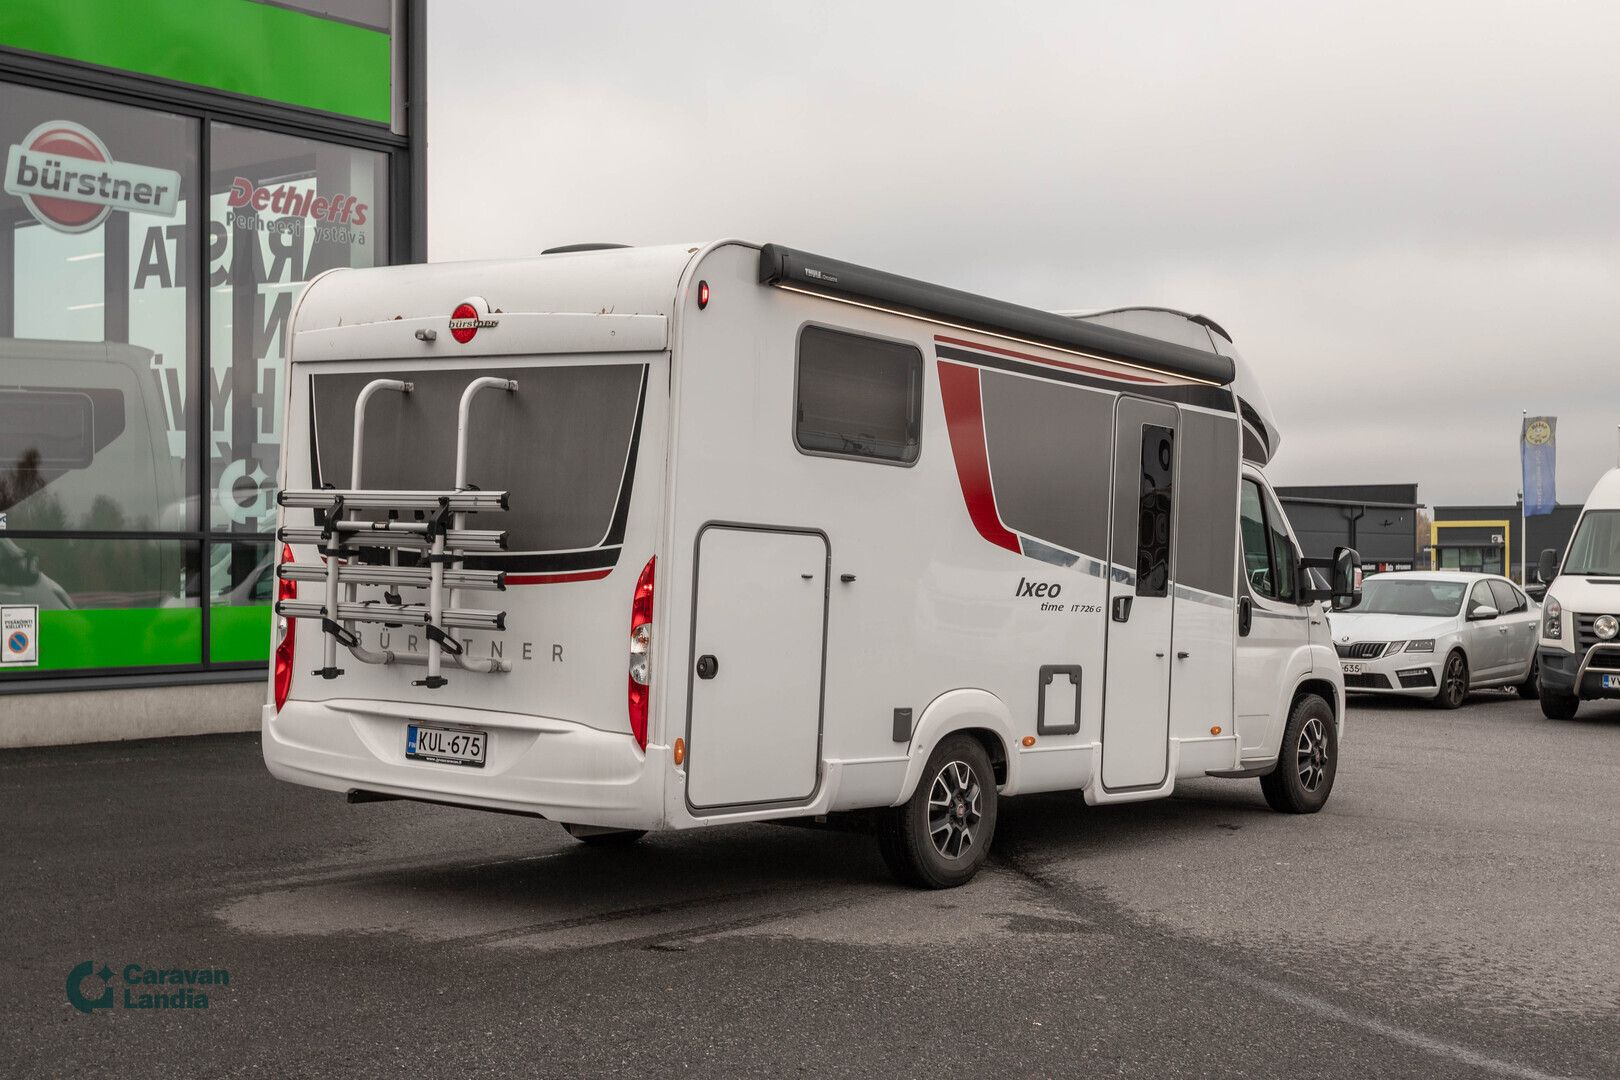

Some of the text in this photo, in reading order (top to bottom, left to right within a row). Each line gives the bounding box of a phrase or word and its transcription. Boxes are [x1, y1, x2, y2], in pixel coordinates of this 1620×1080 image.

[16, 155, 168, 206] bürstner
[227, 176, 368, 226] Dethleffs
[1016, 577, 1061, 598] Ixeo
[1041, 602, 1064, 612] time
[1080, 605, 1094, 613] 726
